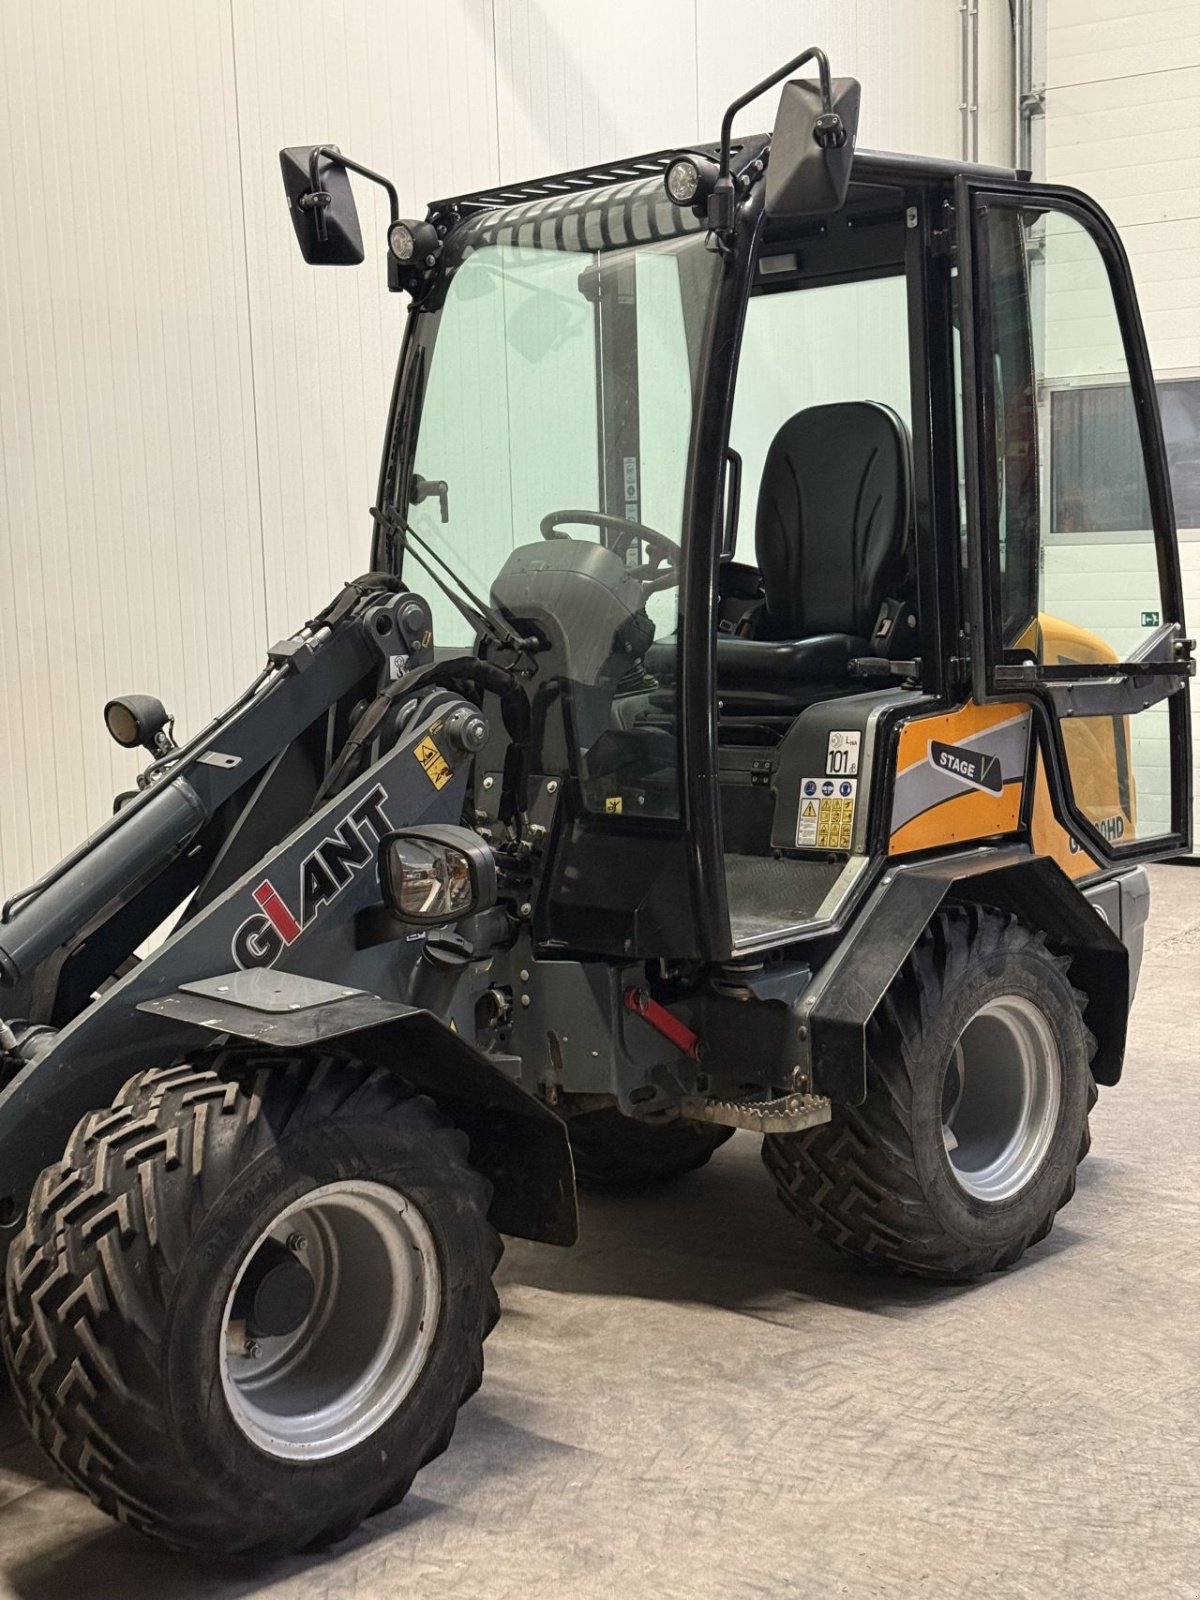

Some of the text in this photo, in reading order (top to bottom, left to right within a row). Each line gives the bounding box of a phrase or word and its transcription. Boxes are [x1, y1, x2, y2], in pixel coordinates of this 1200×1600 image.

[829, 750, 849, 773] 101
[939, 751, 997, 782] STAGE V
